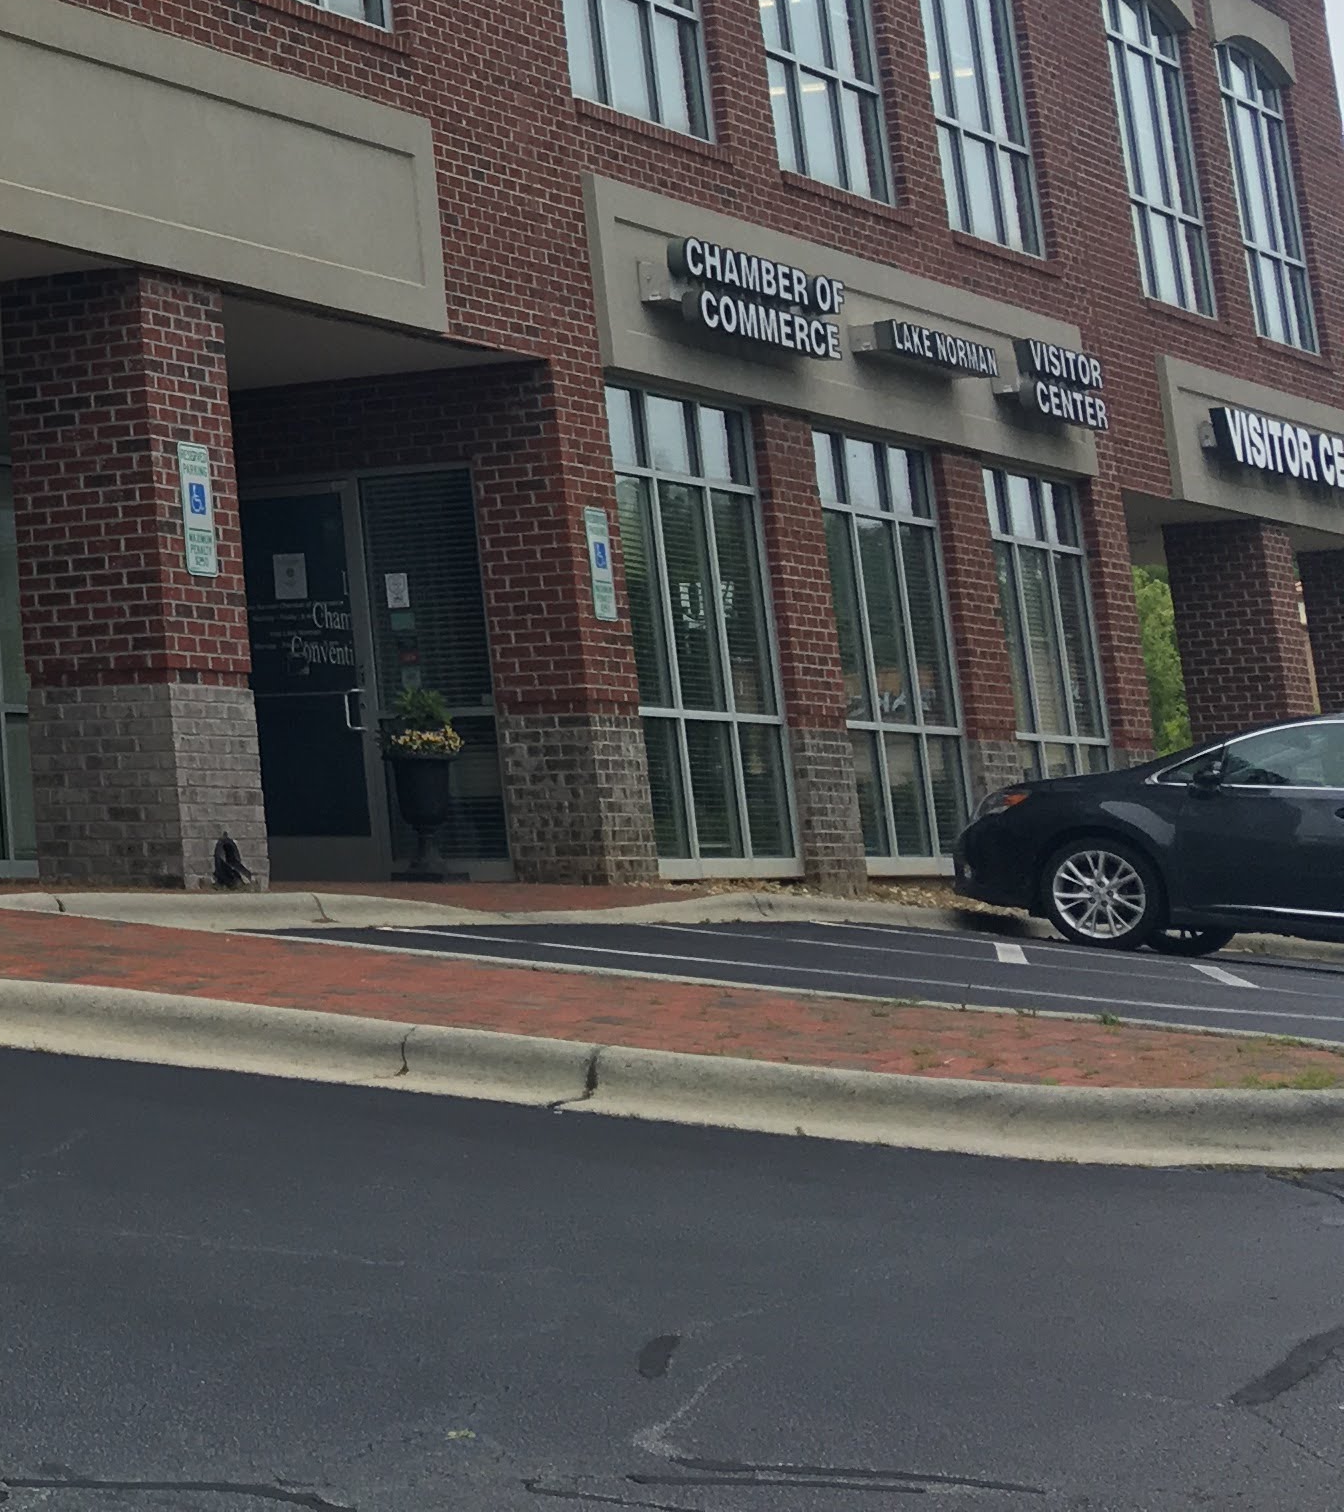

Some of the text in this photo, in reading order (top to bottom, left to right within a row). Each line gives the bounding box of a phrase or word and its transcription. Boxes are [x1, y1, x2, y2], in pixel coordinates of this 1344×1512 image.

[686, 239, 844, 313] CHAMBER OF
[701, 290, 842, 359] COMMERCE
[893, 320, 998, 376] LAKE NORMAN
[1030, 340, 1103, 388] VISITOR
[1036, 382, 1108, 429] CENTER
[1224, 407, 1318, 481] VISITOR
